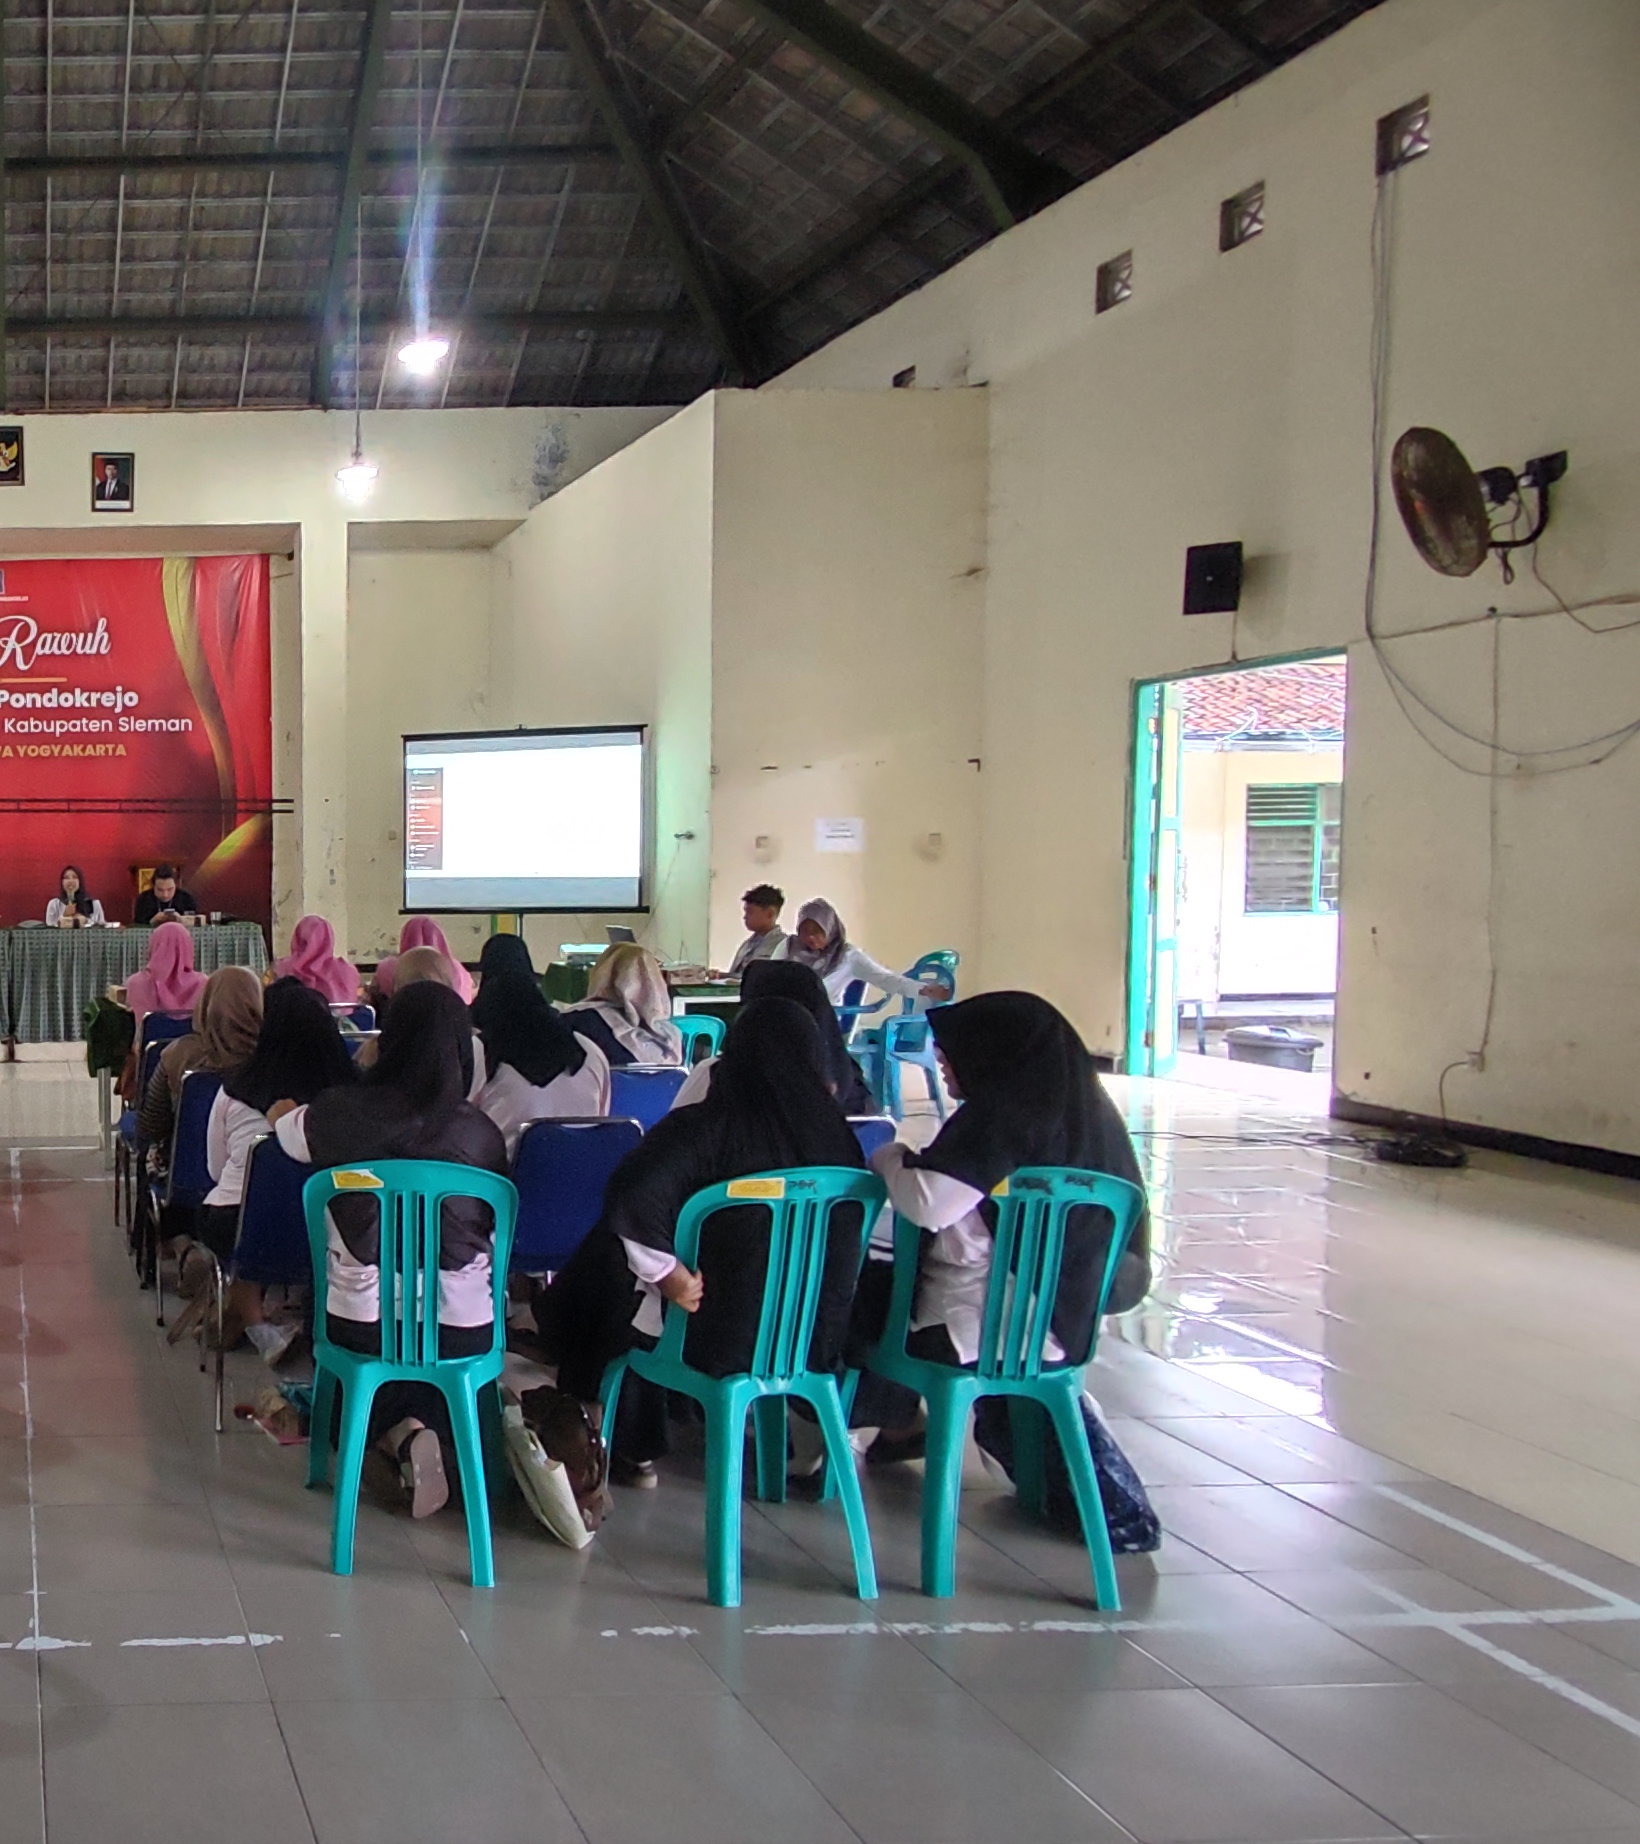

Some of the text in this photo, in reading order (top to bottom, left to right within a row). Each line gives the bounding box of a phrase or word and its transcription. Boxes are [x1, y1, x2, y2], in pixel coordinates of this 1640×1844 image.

[4, 717, 113, 738] Kabupaten
[118, 716, 193, 733] Sleman
[16, 743, 127, 758] YOGYAKARTA
